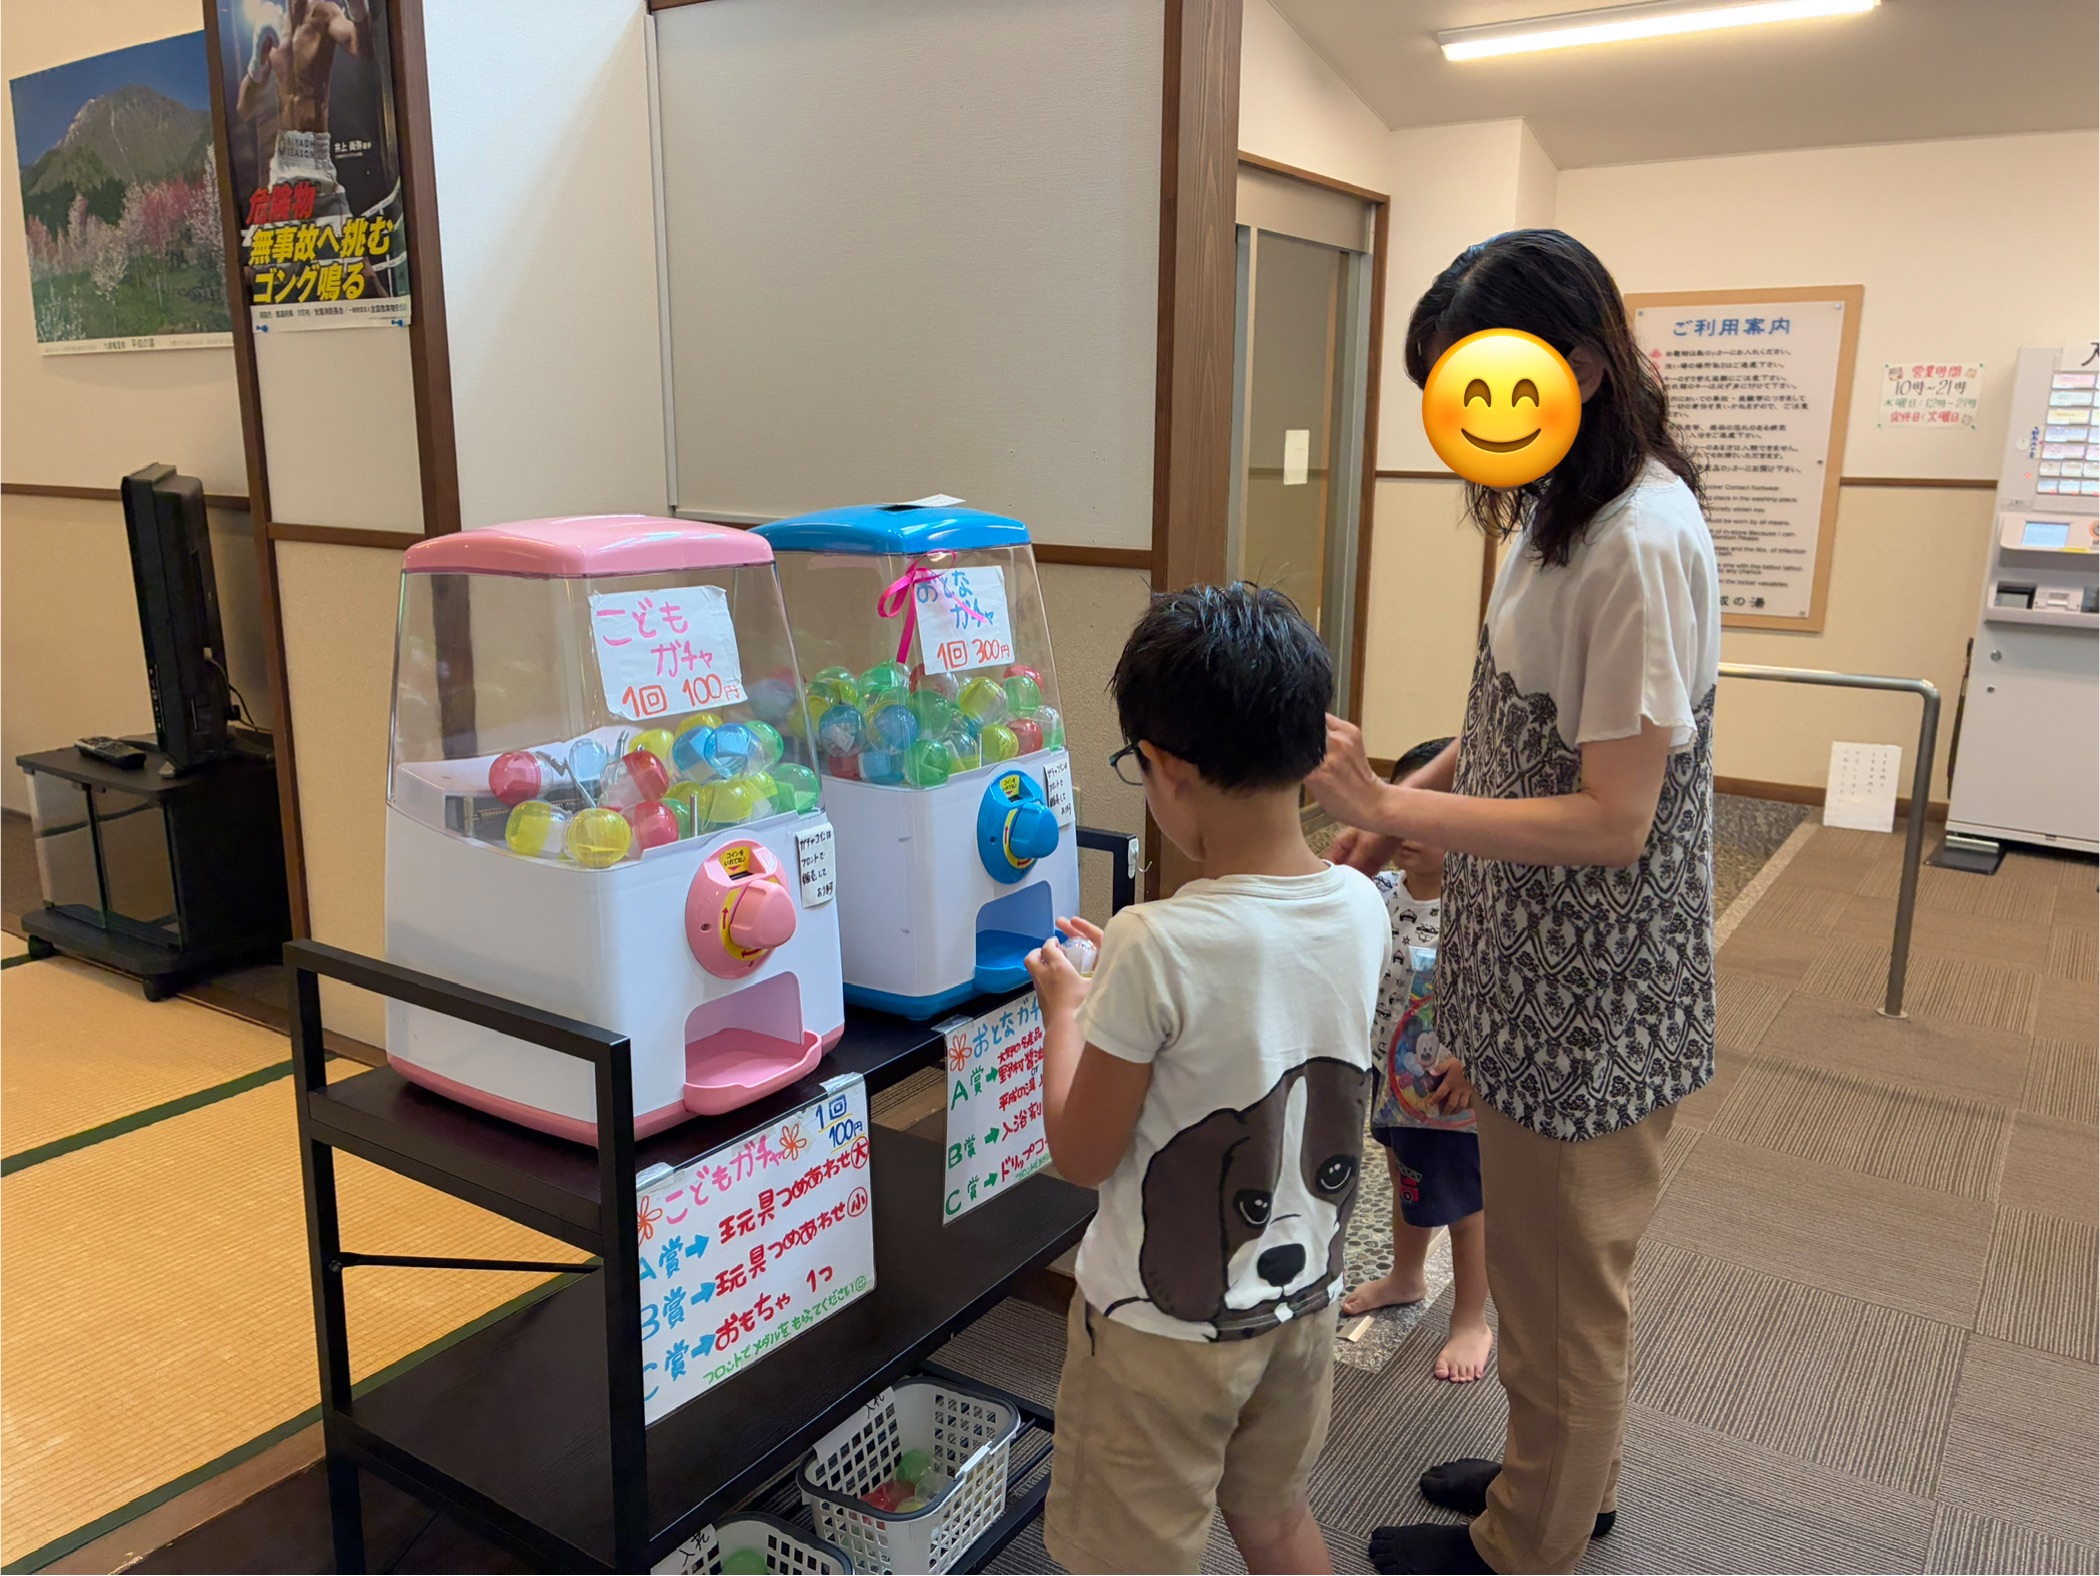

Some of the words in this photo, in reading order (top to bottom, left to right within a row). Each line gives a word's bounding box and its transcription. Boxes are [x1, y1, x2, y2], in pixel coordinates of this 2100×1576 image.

[246, 181, 317, 225] 危険物
[248, 216, 394, 266] 無事故へ挑む
[253, 261, 365, 303] ゴング鳴る
[1673, 317, 1791, 336] ご利用案内
[1912, 365, 1962, 379] 営業時間
[916, 570, 973, 604] おとな
[596, 597, 688, 647] こども
[950, 598, 994, 629] ガチャ
[650, 639, 713, 678] ガチャ
[937, 640, 968, 671] 1回
[972, 639, 1010, 664] 300円
[622, 685, 668, 718] 1回
[682, 673, 740, 707] 100円
[726, 849, 743, 859] コインを
[801, 852, 825, 868] フロントで
[802, 868, 827, 886] 販売して
[972, 996, 1042, 1058] おとなガチ
[950, 1065, 984, 1111] A賞
[998, 1047, 1044, 1084] 野村醤油
[1031, 1064, 1039, 1076] or
[815, 1094, 847, 1129] 1回
[829, 1119, 863, 1148] 100円
[948, 1134, 976, 1169] B賞
[1002, 1101, 1042, 1142] 入浴剤
[665, 1134, 783, 1224] こどもガチャ
[945, 1175, 979, 1216] C賞
[715, 1292, 791, 1351] おもちゃ
[806, 1265, 833, 1293] 1つ
[678, 1531, 710, 1567] 入れ
